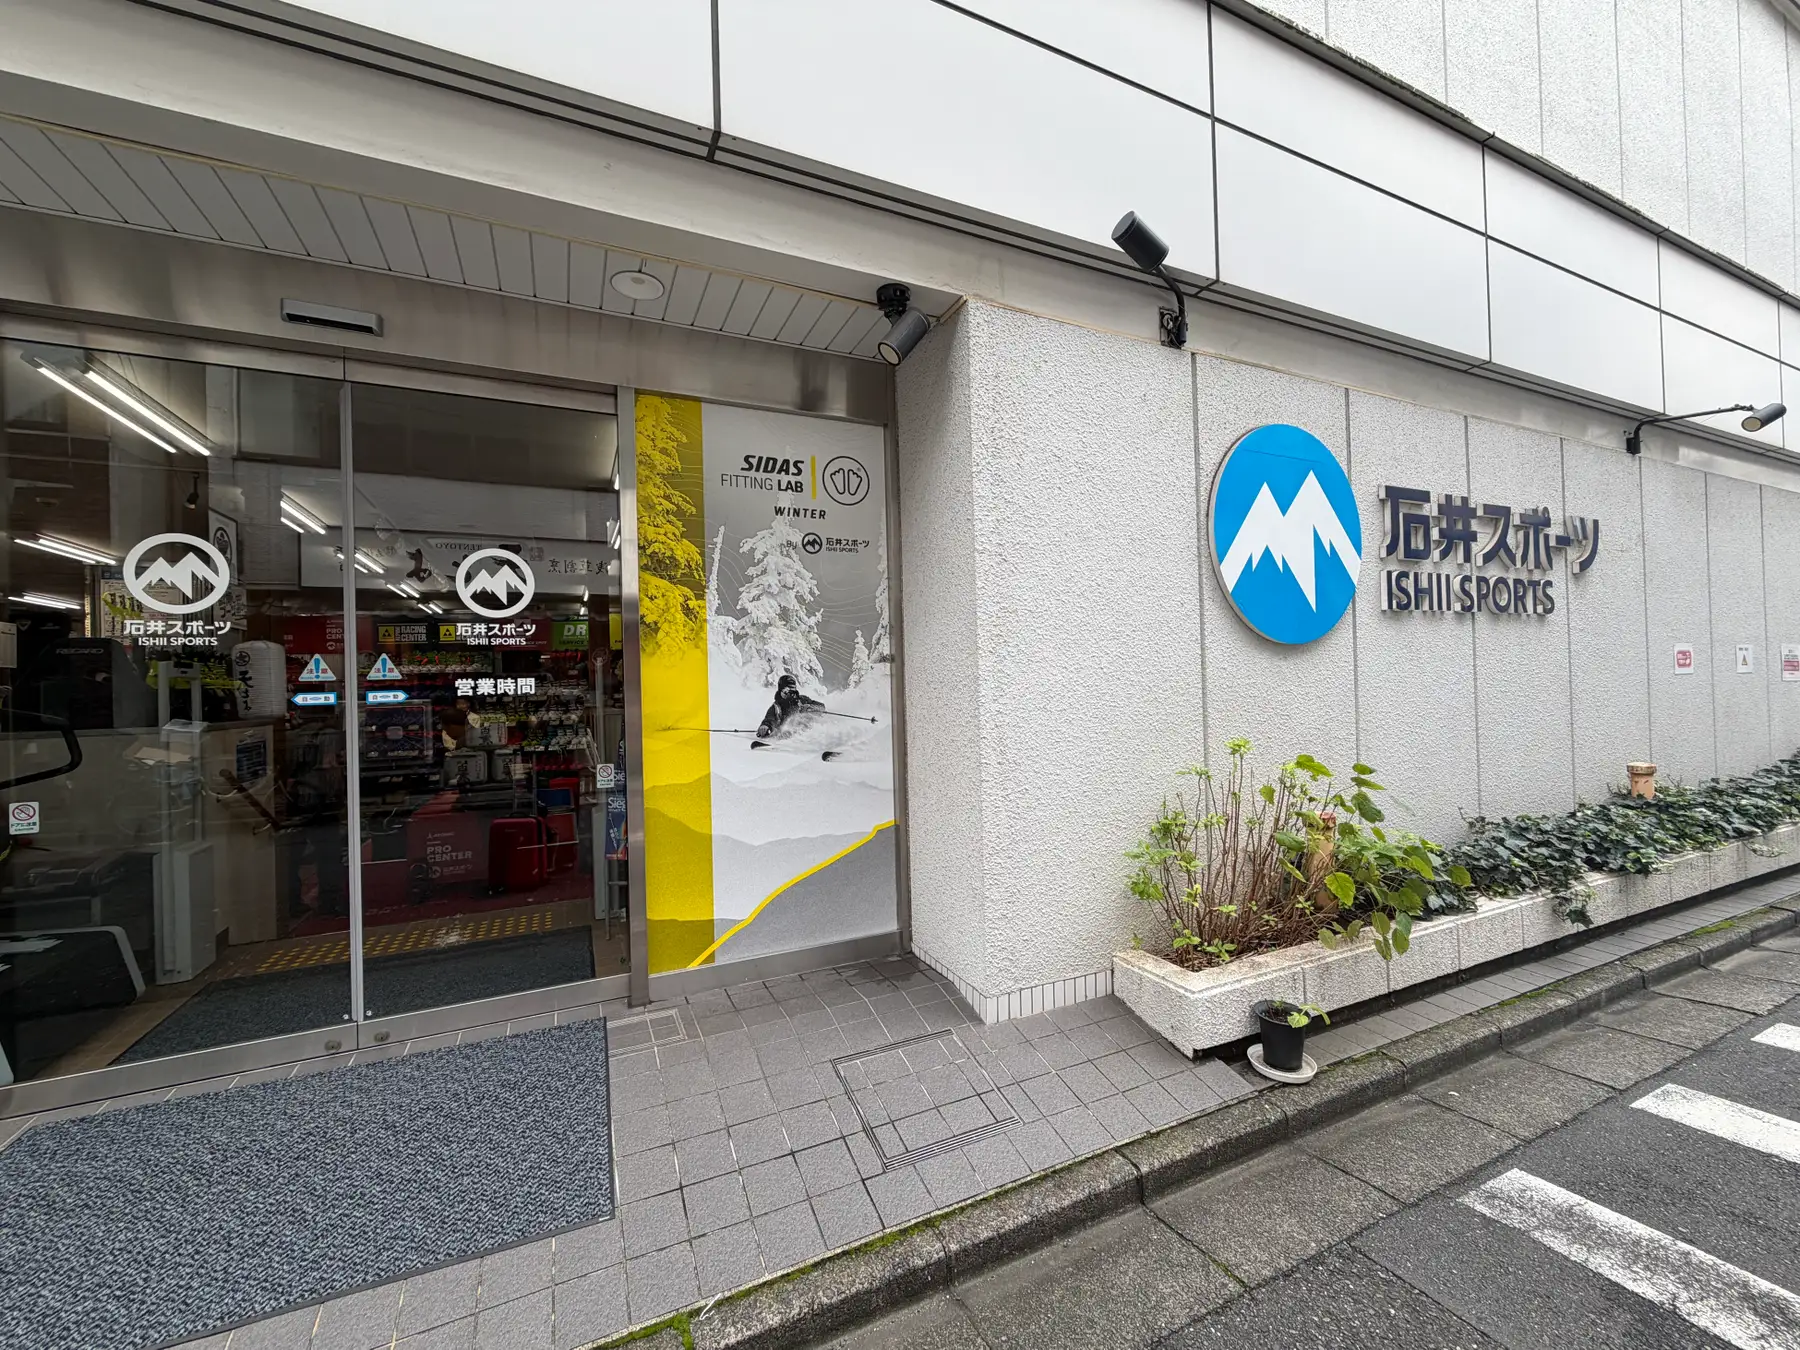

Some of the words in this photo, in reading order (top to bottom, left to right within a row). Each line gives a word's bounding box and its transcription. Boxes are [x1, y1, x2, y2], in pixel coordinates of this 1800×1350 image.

[741, 454, 804, 477] SIDAS
[721, 473, 773, 491] FITTING
[777, 479, 804, 493] LAB
[774, 506, 826, 520] WINTER
[1379, 485, 1599, 575] 石井スポーツ
[825, 537, 870, 548] 石井スポーツ
[1381, 570, 1451, 611] ISHII
[1453, 574, 1555, 615] SPORTS
[123, 619, 231, 635] 石井スポーツ
[456, 622, 536, 637] 石井スポーツ
[138, 637, 167, 646] ISHII
[170, 637, 218, 646] SPORTS
[467, 637, 488, 646] ISHII
[490, 637, 527, 646] SPORTS
[455, 677, 536, 696] 営業時間
[427, 844, 452, 855] PRO
[427, 850, 472, 863] CENTER
